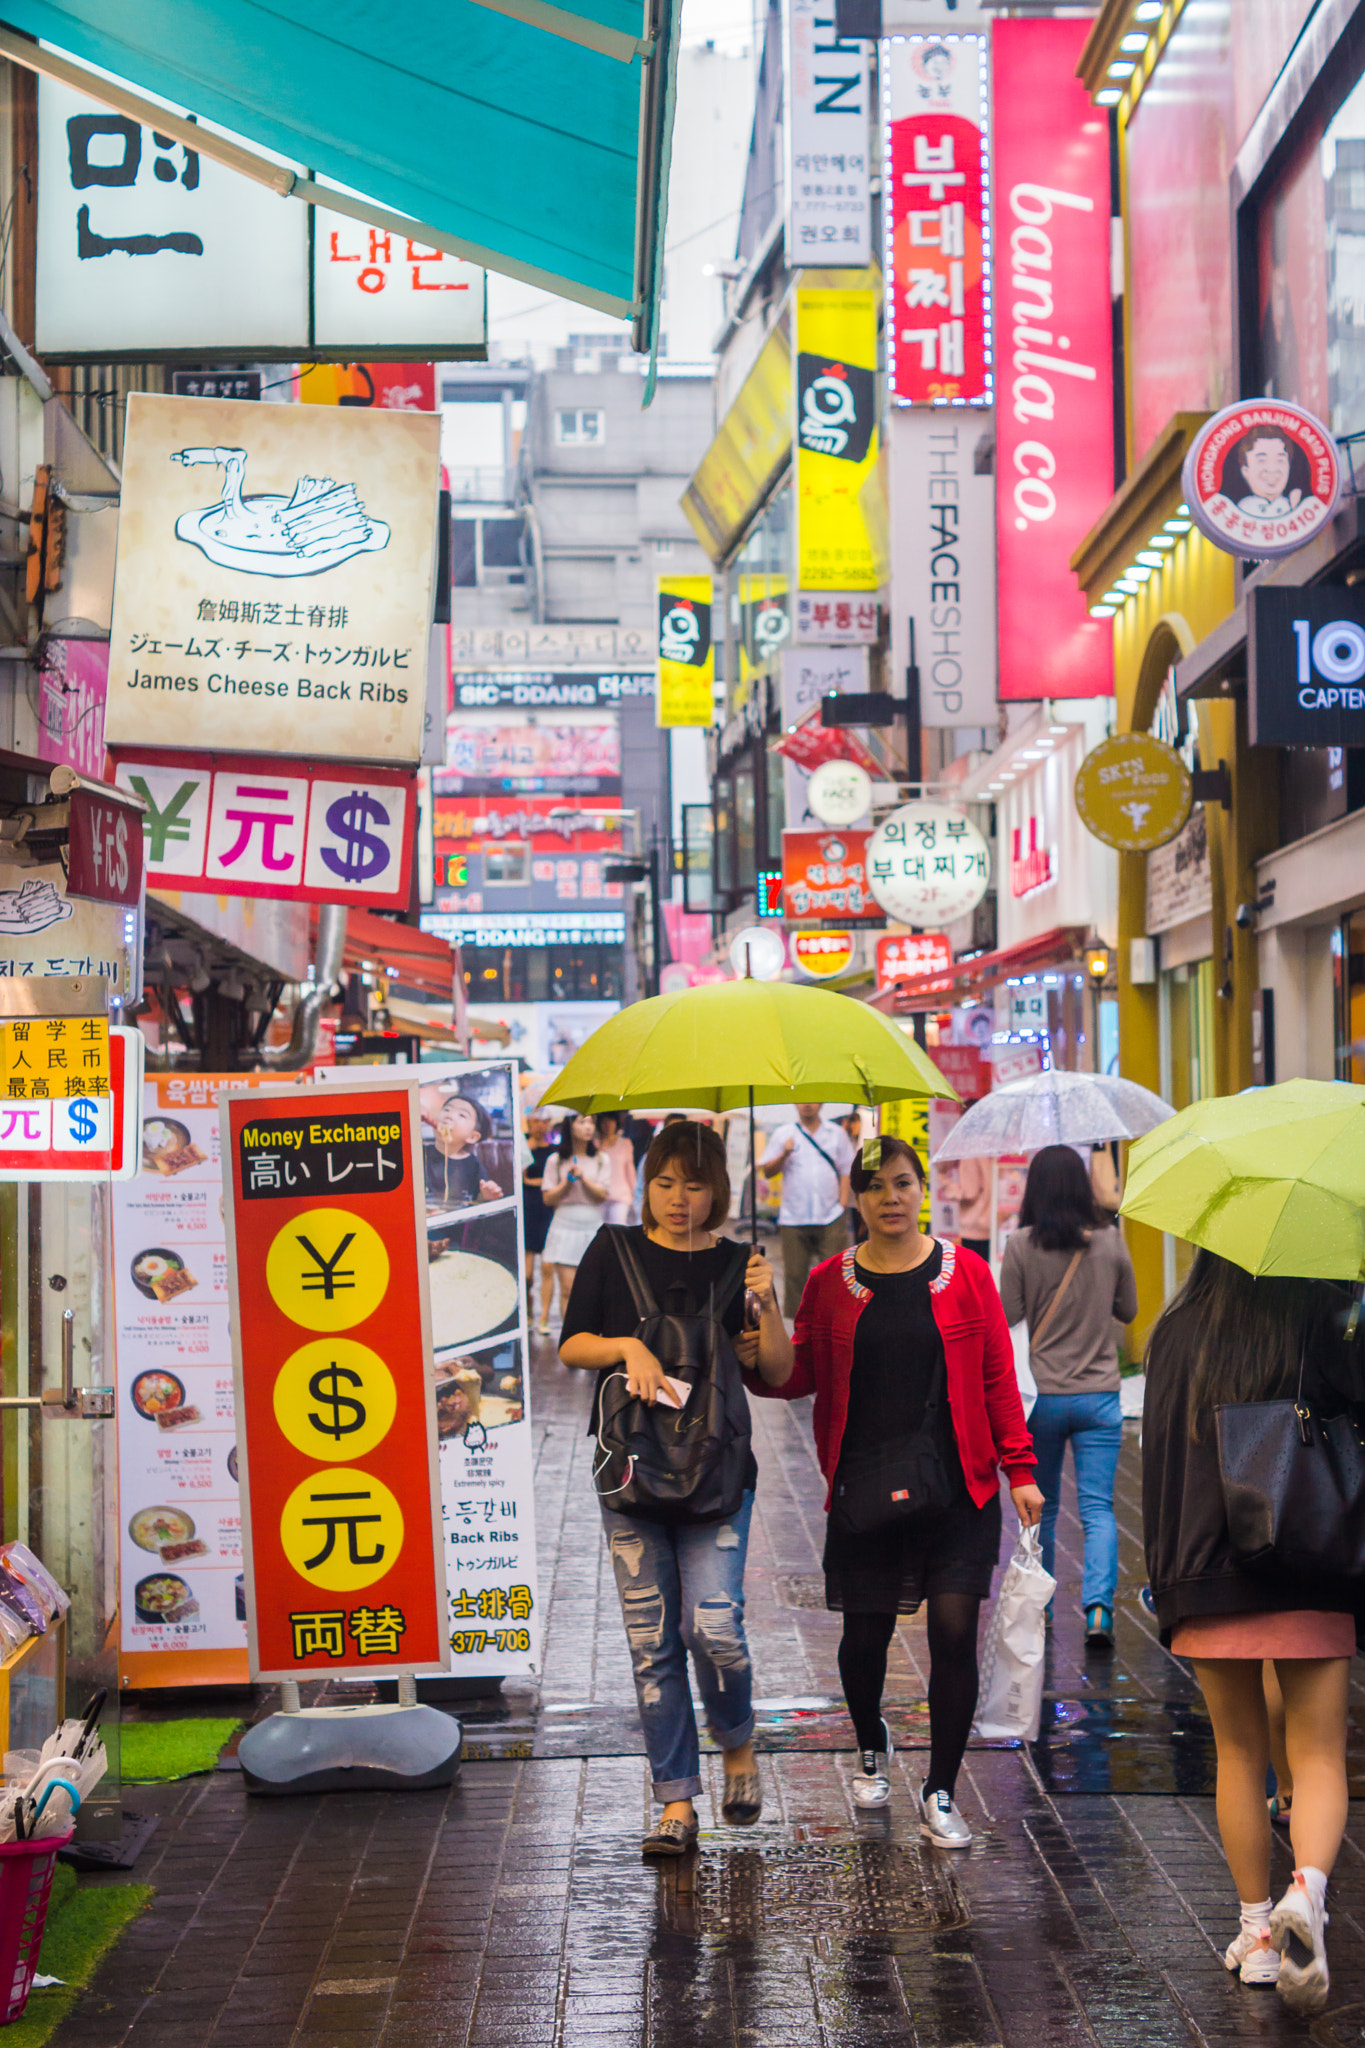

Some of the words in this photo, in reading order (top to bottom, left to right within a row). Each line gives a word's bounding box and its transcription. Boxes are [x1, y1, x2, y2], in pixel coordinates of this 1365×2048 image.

[902, 134, 966, 376] 부대찌개
[1009, 182, 1097, 424] banila
[1201, 419, 1242, 493] HONGKONG
[1316, 457, 1331, 496] PLUS
[1012, 440, 1057, 531] co.
[196, 598, 350, 629] 詹姆斯芝士脊排
[127, 669, 199, 692] James
[207, 673, 289, 698] Cheese
[296, 678, 352, 701] Back
[360, 682, 409, 705] Ribs
[459, 684, 598, 706] SIC-DDANG
[1098, 757, 1145, 785] SKIN
[218, 786, 295, 872] 元
[320, 790, 391, 884] $
[883, 818, 969, 850] 의정부
[872, 852, 988, 884] 부대찌개
[12, 1020, 103, 1042] 留学生
[12, 1047, 102, 1070] 人民币
[7, 1077, 50, 1098] 最高
[68, 1098, 99, 1144] $
[243, 1127, 304, 1150] Money
[309, 1122, 401, 1146] Exchange
[247, 1151, 311, 1191] 高い
[326, 1148, 397, 1183] レート
[295, 1232, 357, 1300] ¥
[307, 1361, 367, 1441] $
[454, 1480, 486, 1488] Extremely
[489, 1480, 505, 1488] spicy
[302, 1491, 385, 1571] 元
[450, 1532, 485, 1544] Back
[490, 1531, 519, 1543] Ribs
[447, 1585, 532, 1620] 士排骨
[289, 1606, 405, 1659] 両替
